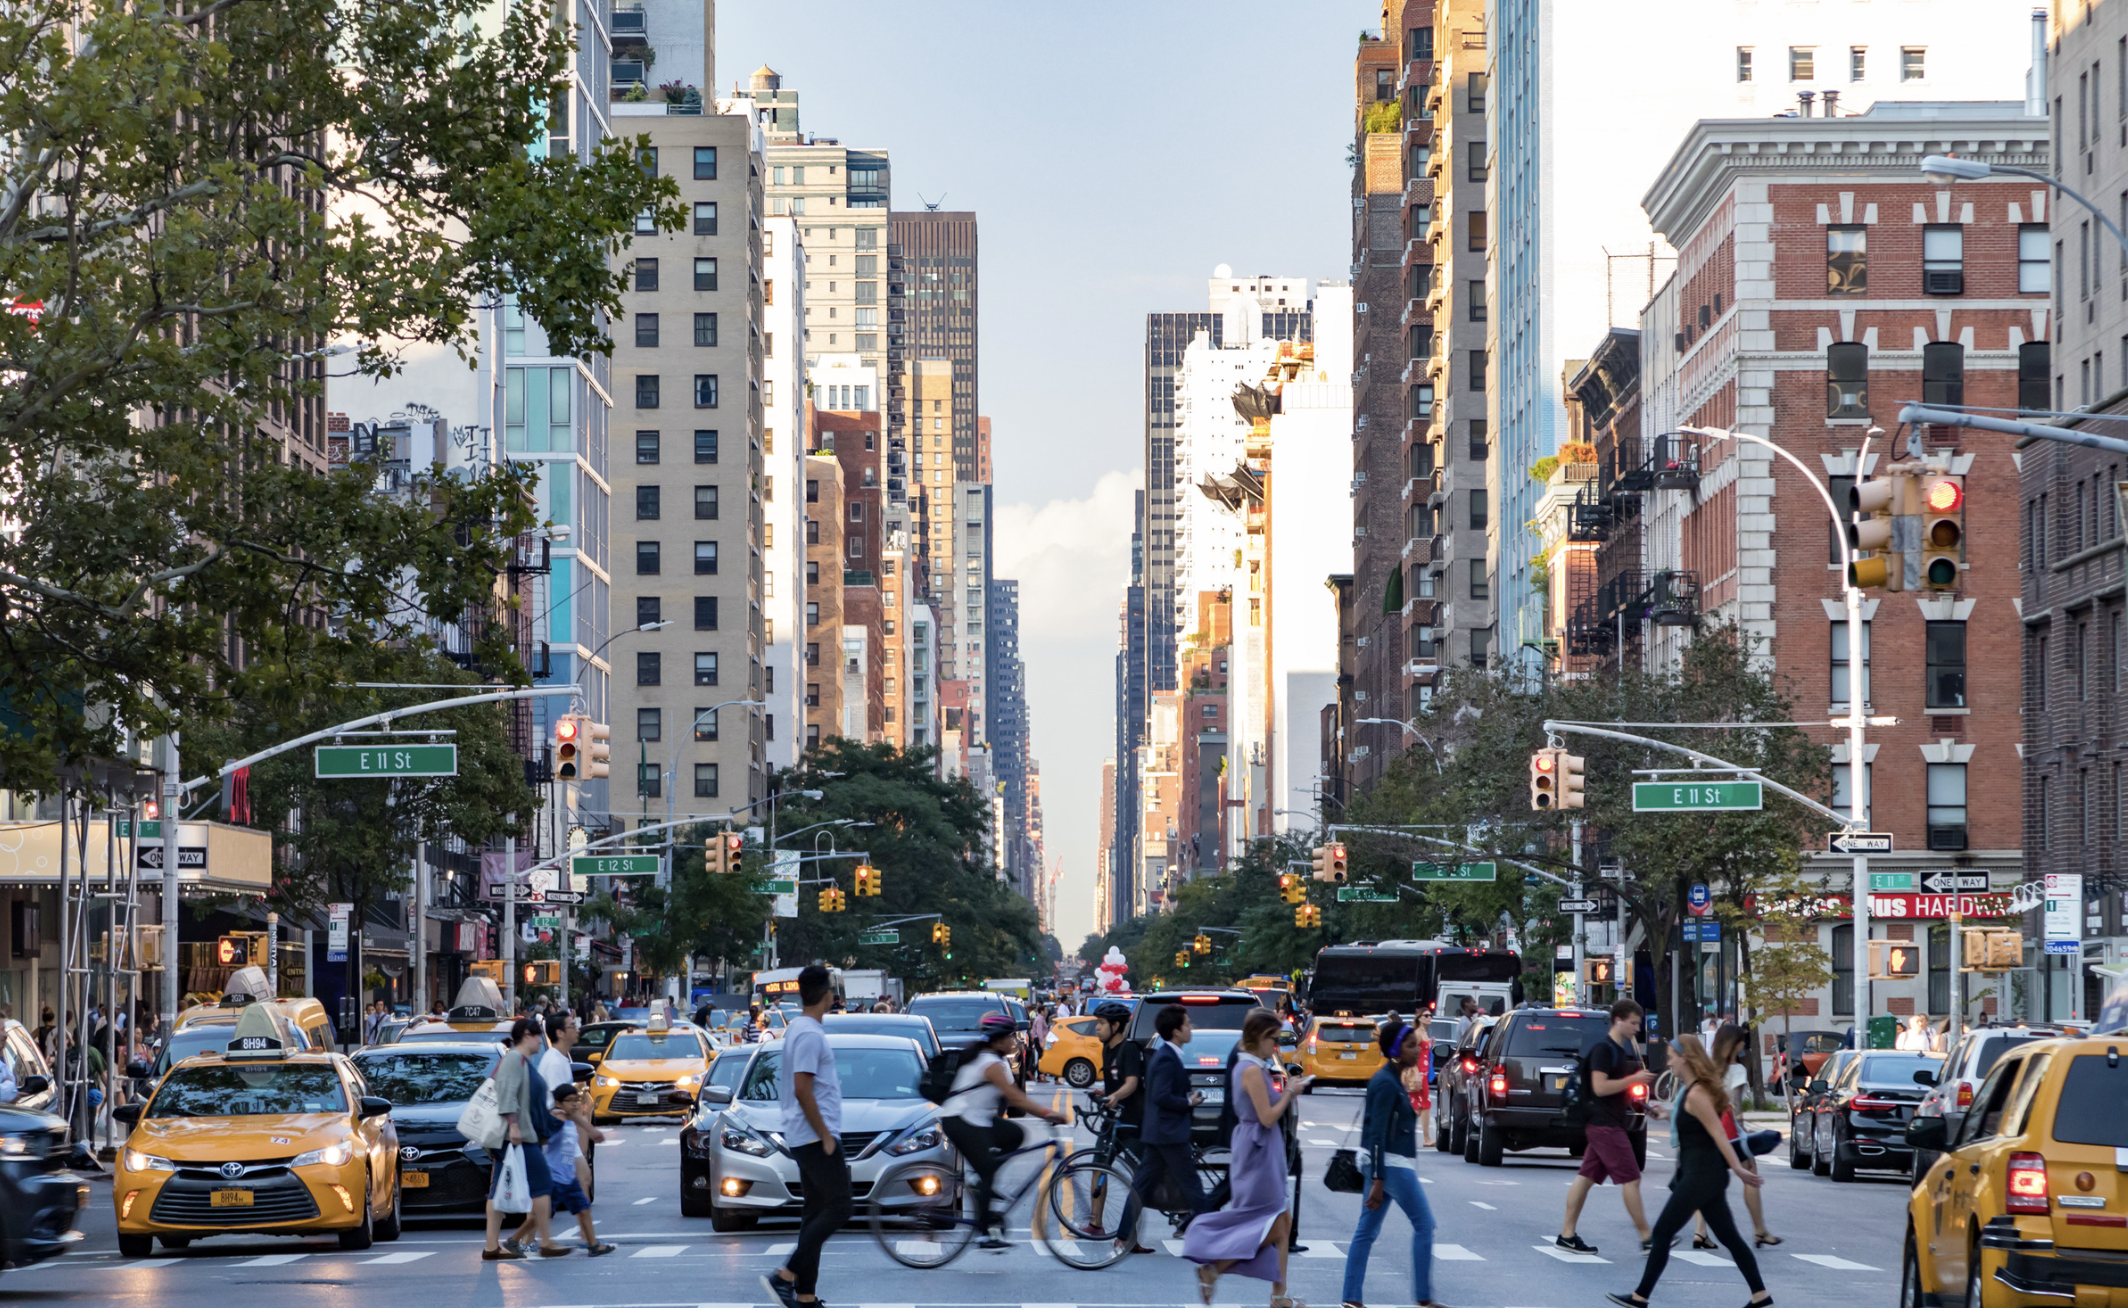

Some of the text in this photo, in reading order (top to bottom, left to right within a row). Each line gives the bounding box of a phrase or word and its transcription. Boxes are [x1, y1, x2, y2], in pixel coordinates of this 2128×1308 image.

[360, 752, 411, 770] E 11 St
[1674, 788, 1720, 804] E 11 St
[122, 823, 128, 836] E
[1840, 838, 1884, 848] ONE WAY
[150, 854, 199, 862] ON WAY
[598, 859, 634, 872] E 12 St
[1438, 866, 1444, 876] E
[1460, 866, 1471, 877] St
[768, 882, 776, 890] St
[1876, 876, 1882, 887] E
[1888, 876, 1894, 887] 11
[1933, 878, 1982, 887] ONE WAY
[1854, 896, 1906, 918] lus
[1916, 897, 2013, 916] HARDWA
[542, 918, 550, 926] 12
[464, 1006, 480, 1016] 7C47
[1651, 1020, 1657, 1030] P
[242, 1037, 266, 1050] 8H94
